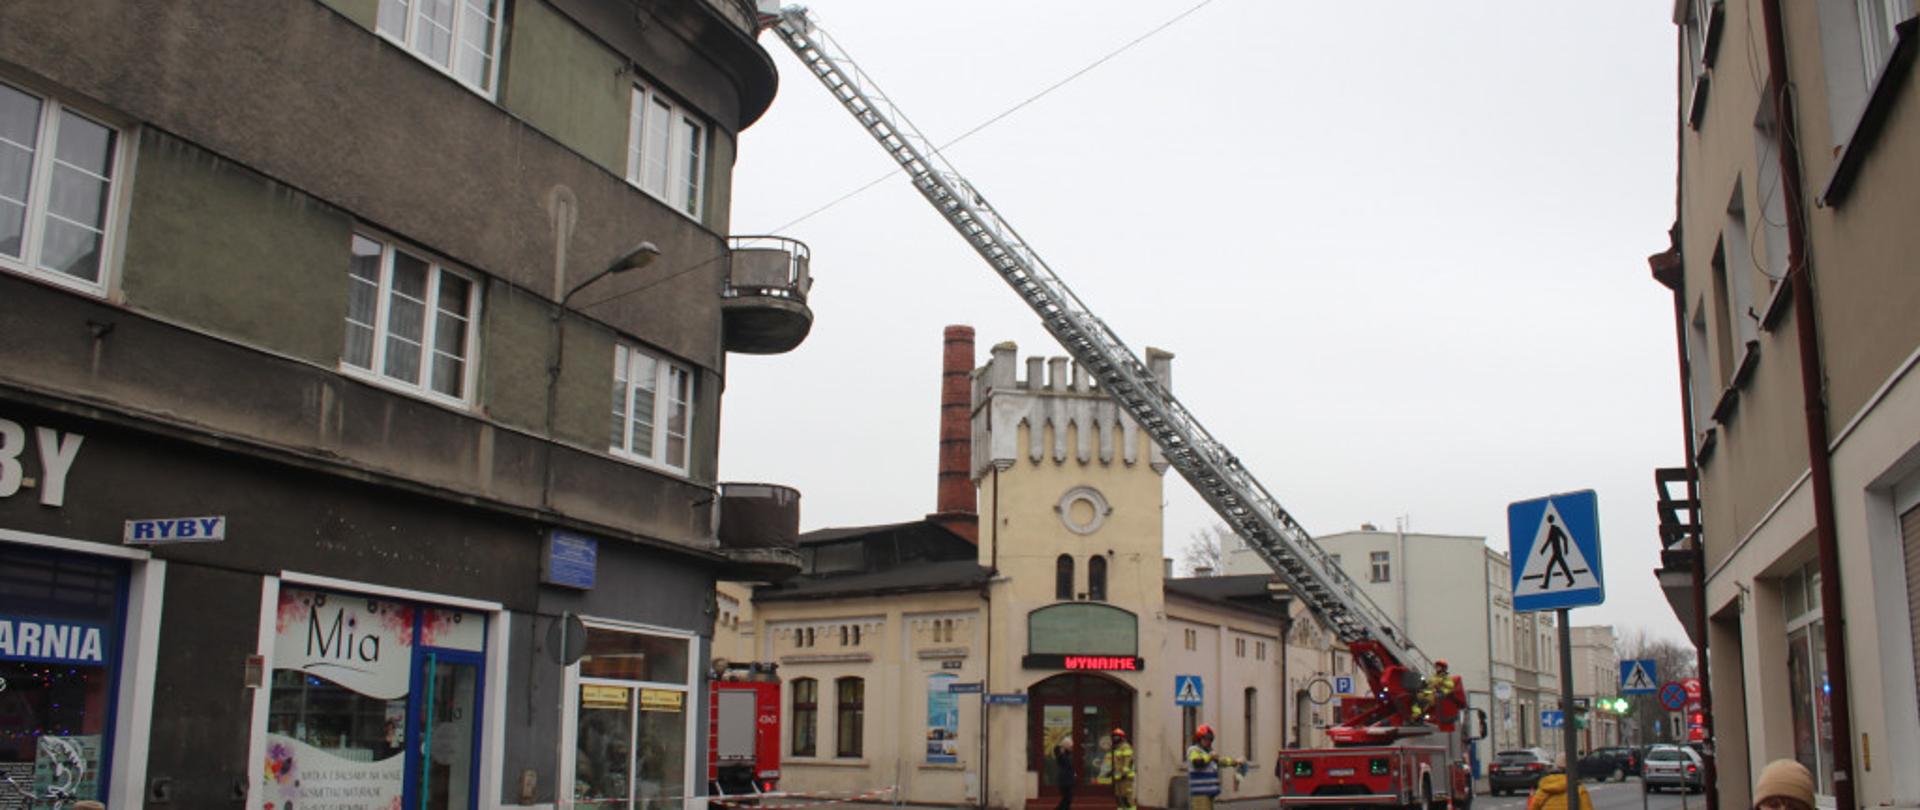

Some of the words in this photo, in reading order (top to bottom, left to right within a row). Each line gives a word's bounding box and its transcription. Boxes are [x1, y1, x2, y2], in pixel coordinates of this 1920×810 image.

[134, 518, 219, 539] RYBY
[0, 620, 102, 661] ARNIA
[307, 604, 379, 662] Mia
[1340, 679, 1348, 692] P
